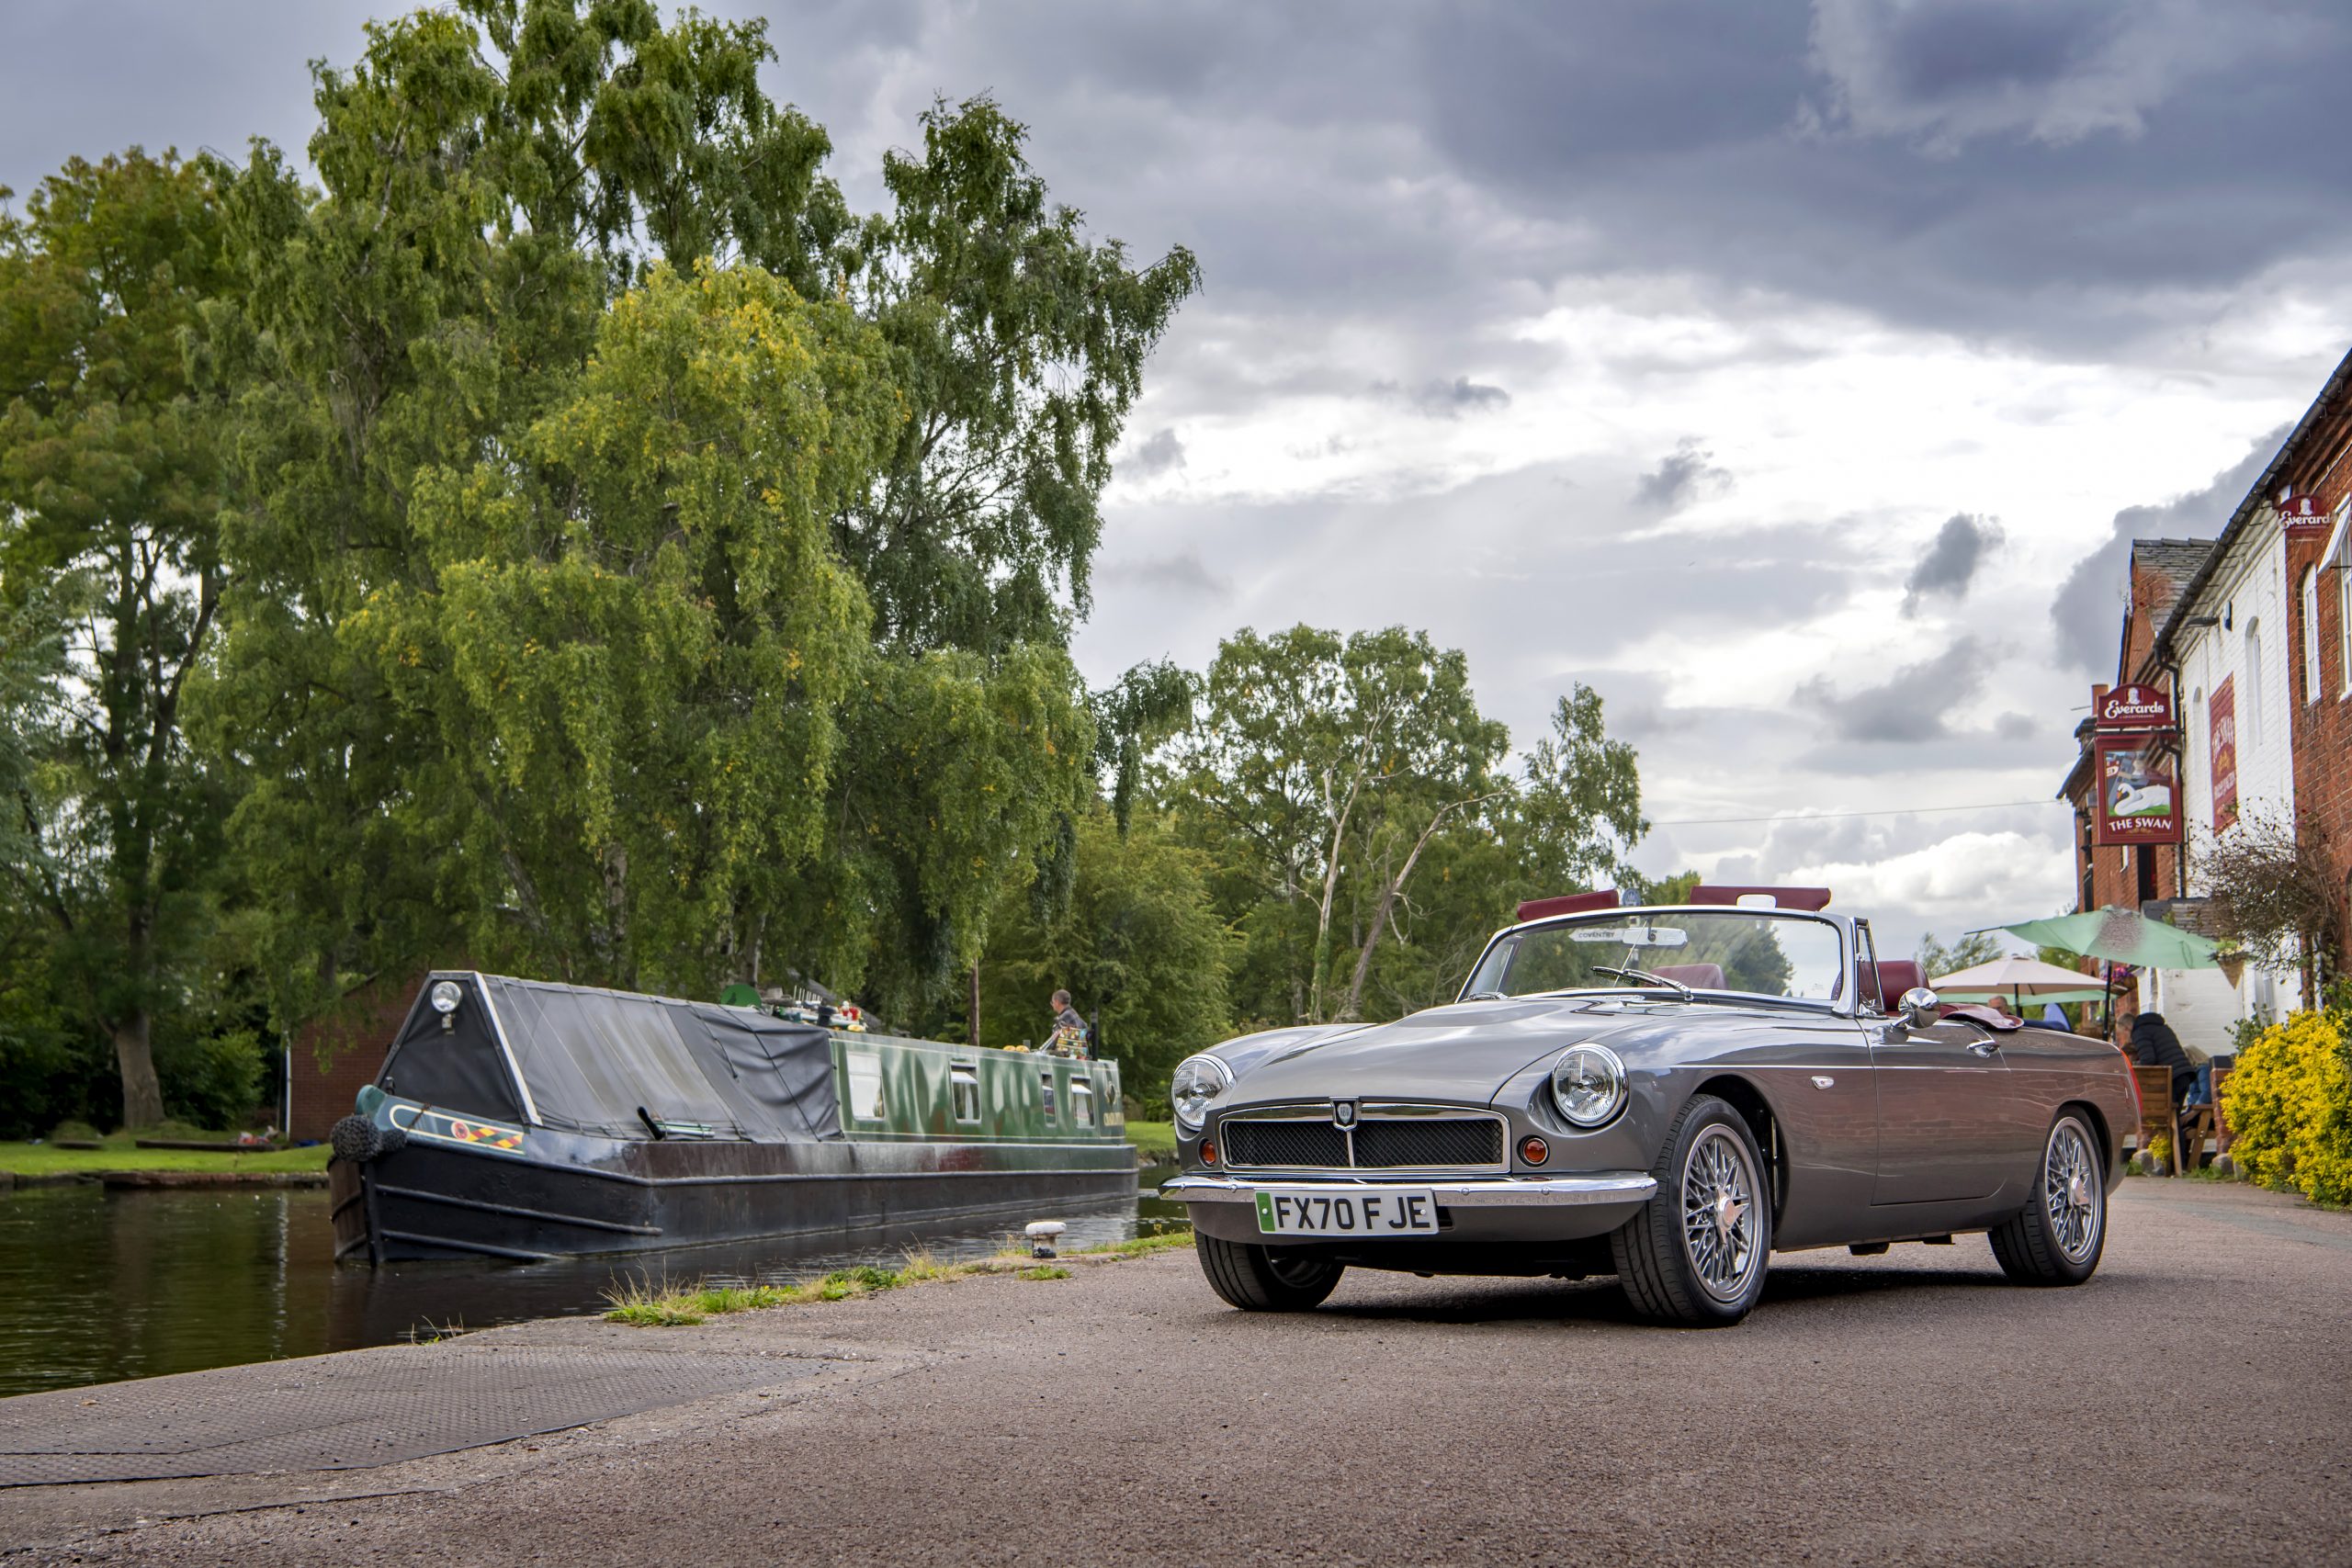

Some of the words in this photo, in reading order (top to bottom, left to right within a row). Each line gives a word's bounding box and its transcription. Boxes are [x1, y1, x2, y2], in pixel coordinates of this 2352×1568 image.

[2104, 700, 2165, 718] Everards
[2109, 818, 2132, 831] THE
[2135, 818, 2172, 829] SWAN
[1274, 1197, 1355, 1230] FX70
